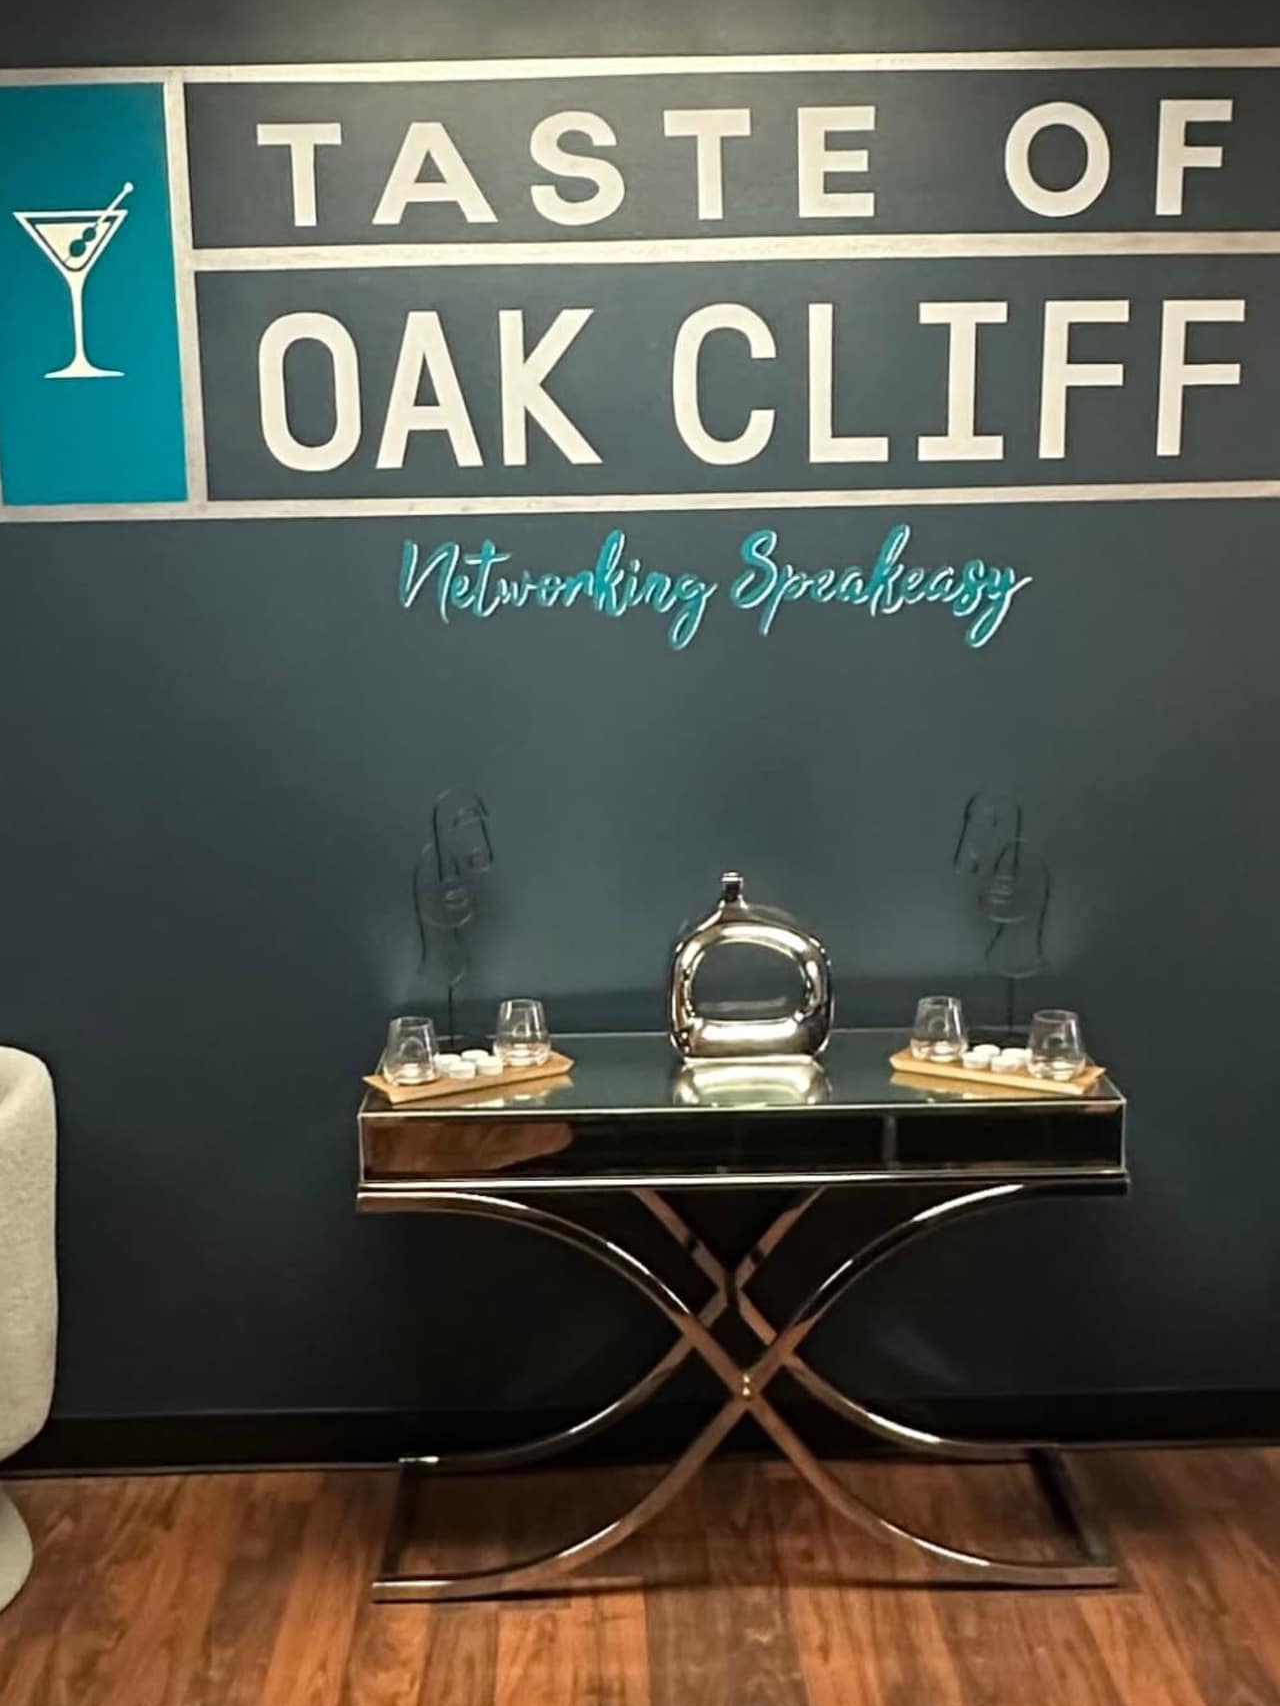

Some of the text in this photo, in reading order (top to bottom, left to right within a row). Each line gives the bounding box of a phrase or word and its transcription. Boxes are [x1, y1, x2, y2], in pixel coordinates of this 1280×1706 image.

[255, 98, 1233, 228] TASTE OF
[257, 298, 1246, 472] OAK CLIFF
[400, 524, 1033, 650] Networking Speakeasy
